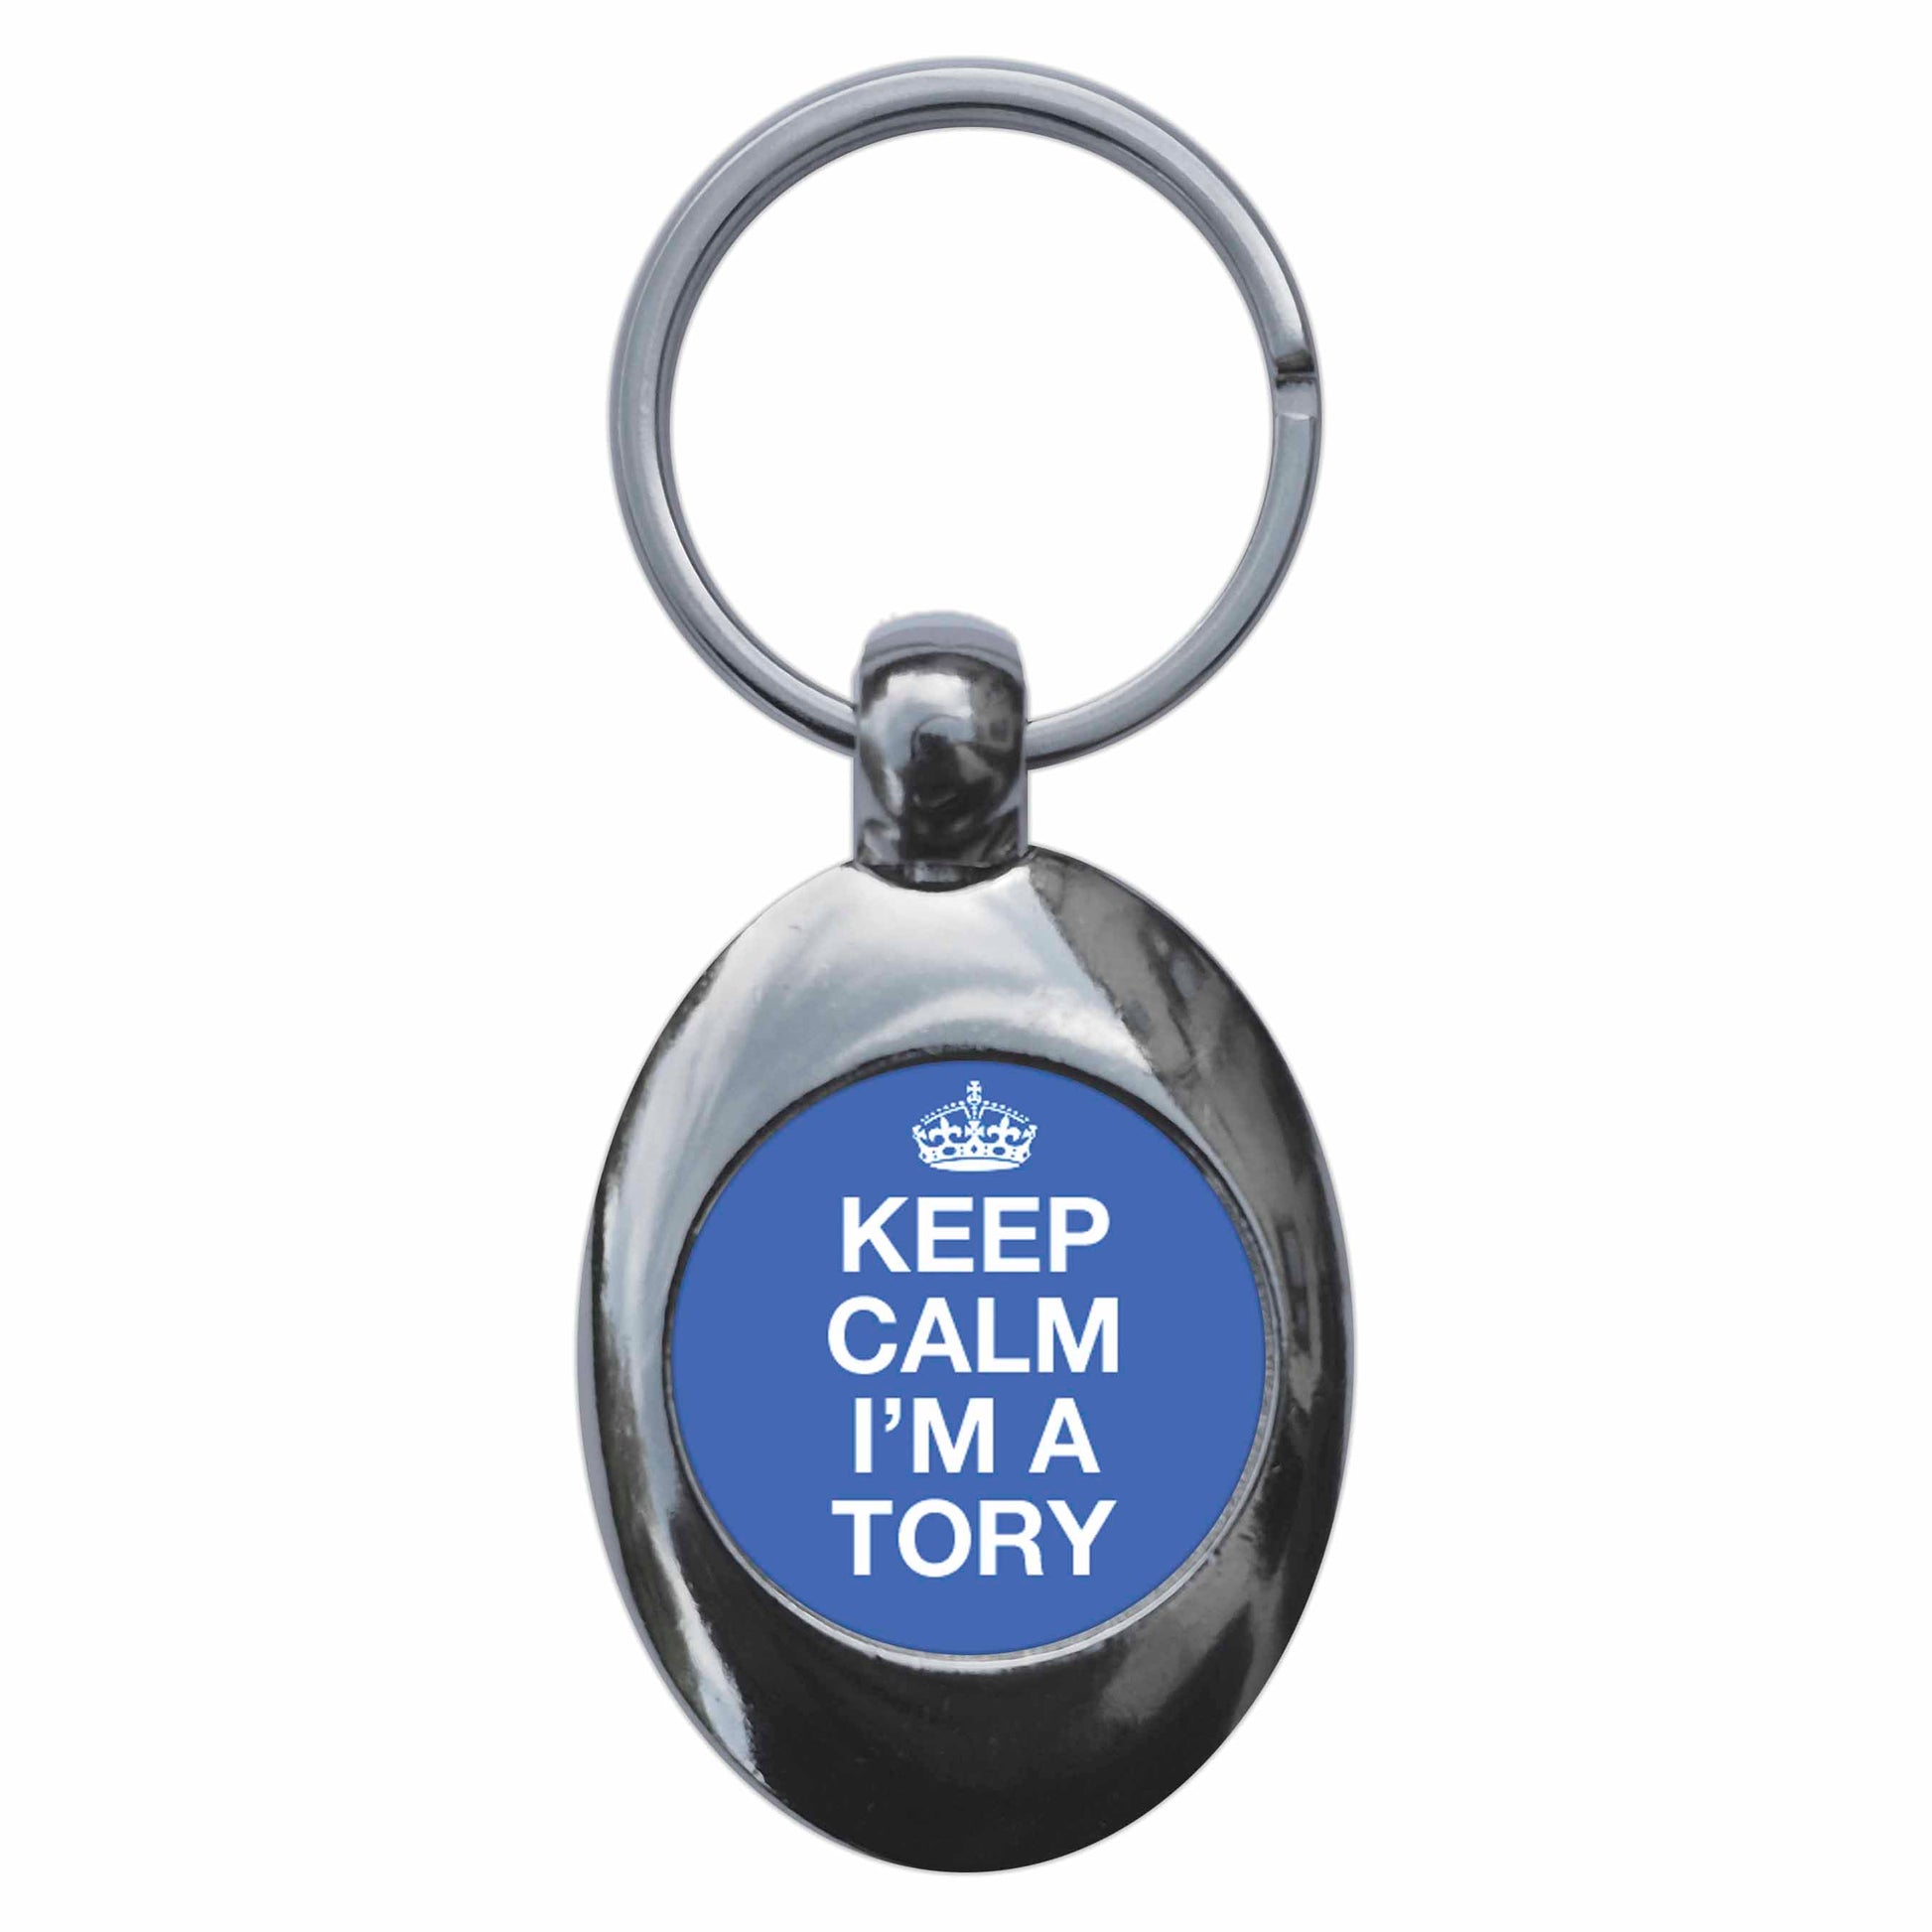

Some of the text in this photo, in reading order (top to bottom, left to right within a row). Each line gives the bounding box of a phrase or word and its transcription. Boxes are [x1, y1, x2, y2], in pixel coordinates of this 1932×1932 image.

[842, 1196, 1111, 1274] KEEP
[826, 1295, 1120, 1375] CALM
[854, 1397, 1102, 1474] I’M A
[831, 1498, 1118, 1578] TORY
